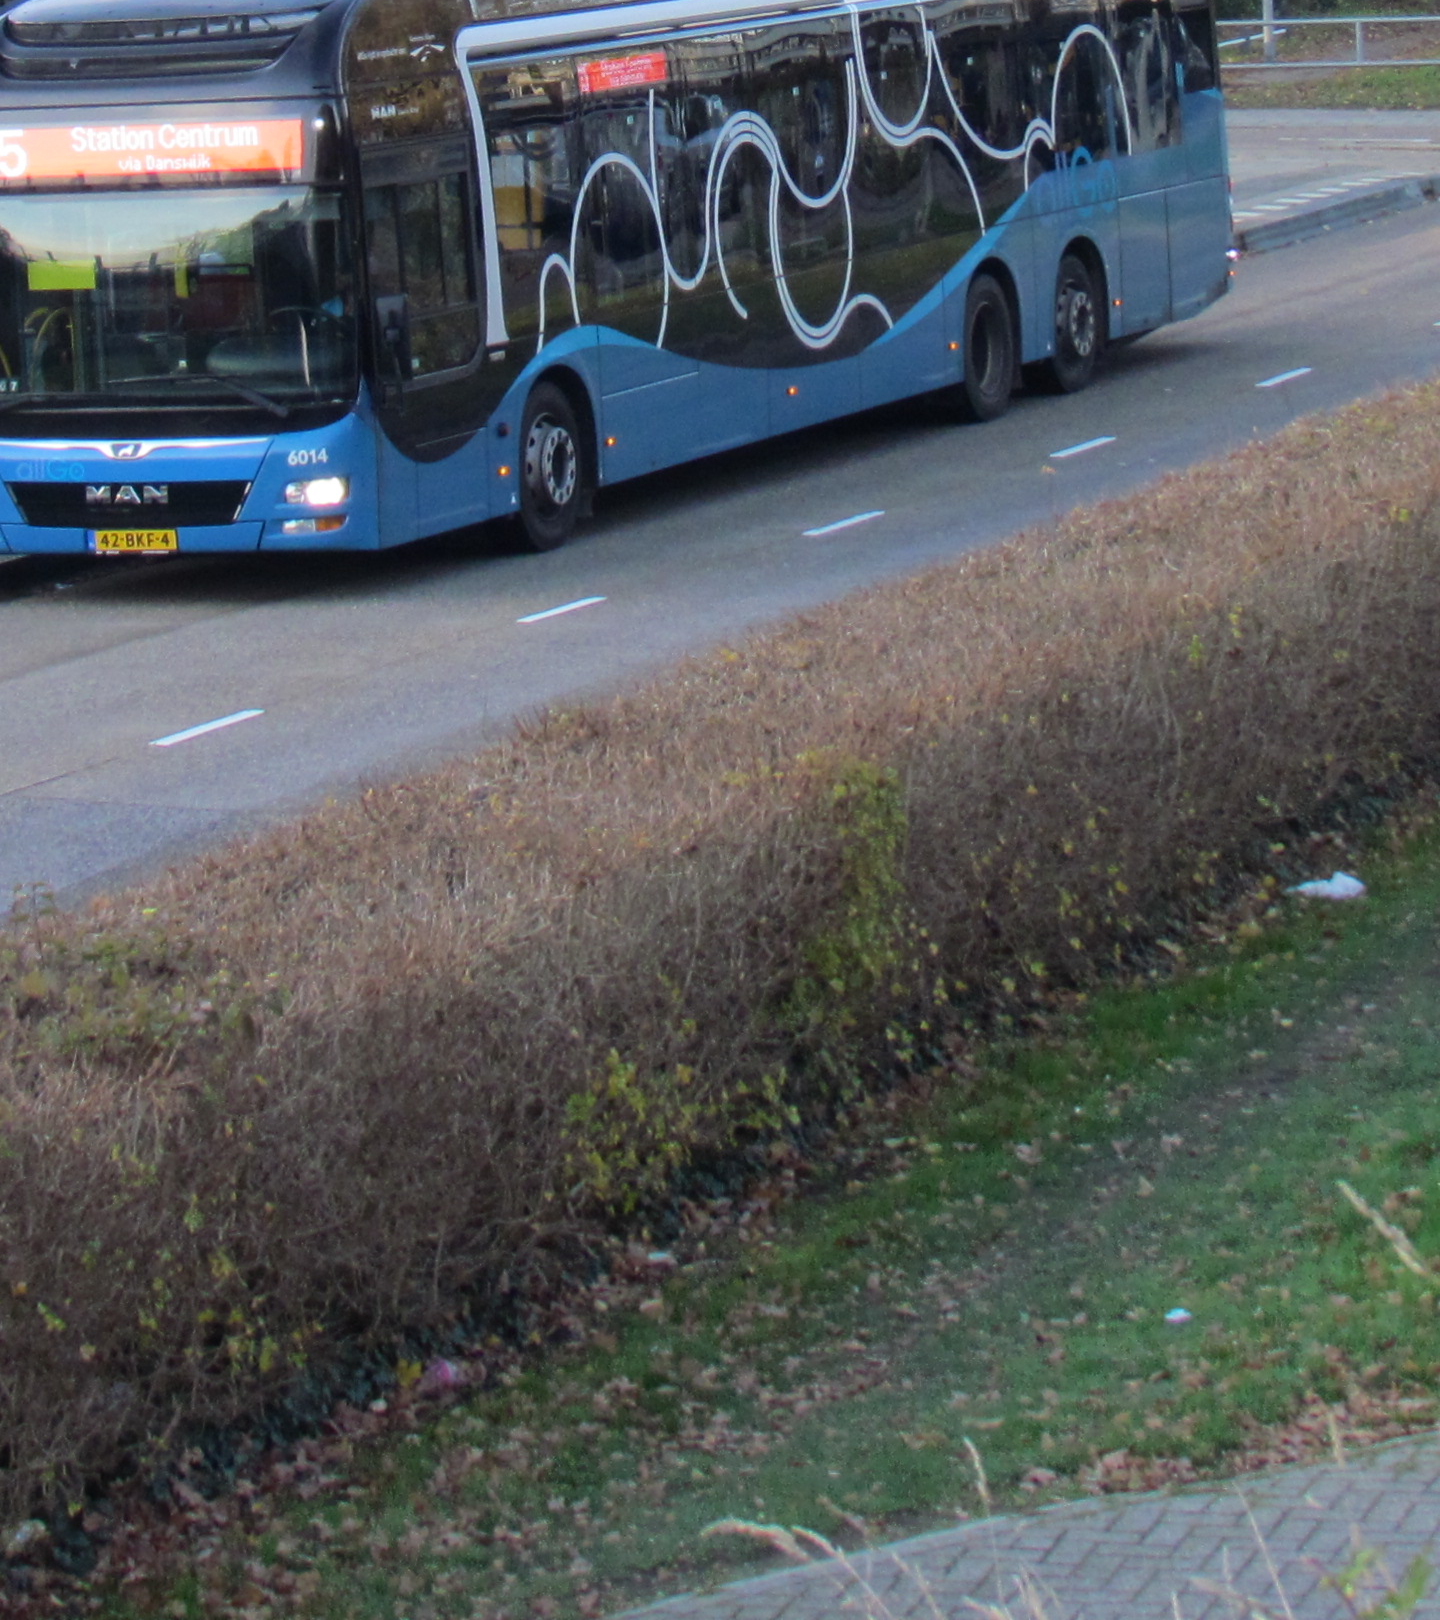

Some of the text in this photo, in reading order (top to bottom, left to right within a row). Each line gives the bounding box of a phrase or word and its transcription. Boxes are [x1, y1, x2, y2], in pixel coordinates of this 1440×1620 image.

[71, 126, 154, 151] Station
[158, 124, 259, 148] Centrum
[119, 154, 212, 171] via Danswijk
[286, 448, 329, 467] 6014
[15, 458, 86, 480] allGo
[85, 485, 169, 504] MAN
[100, 532, 170, 548] 42-BKF-4
